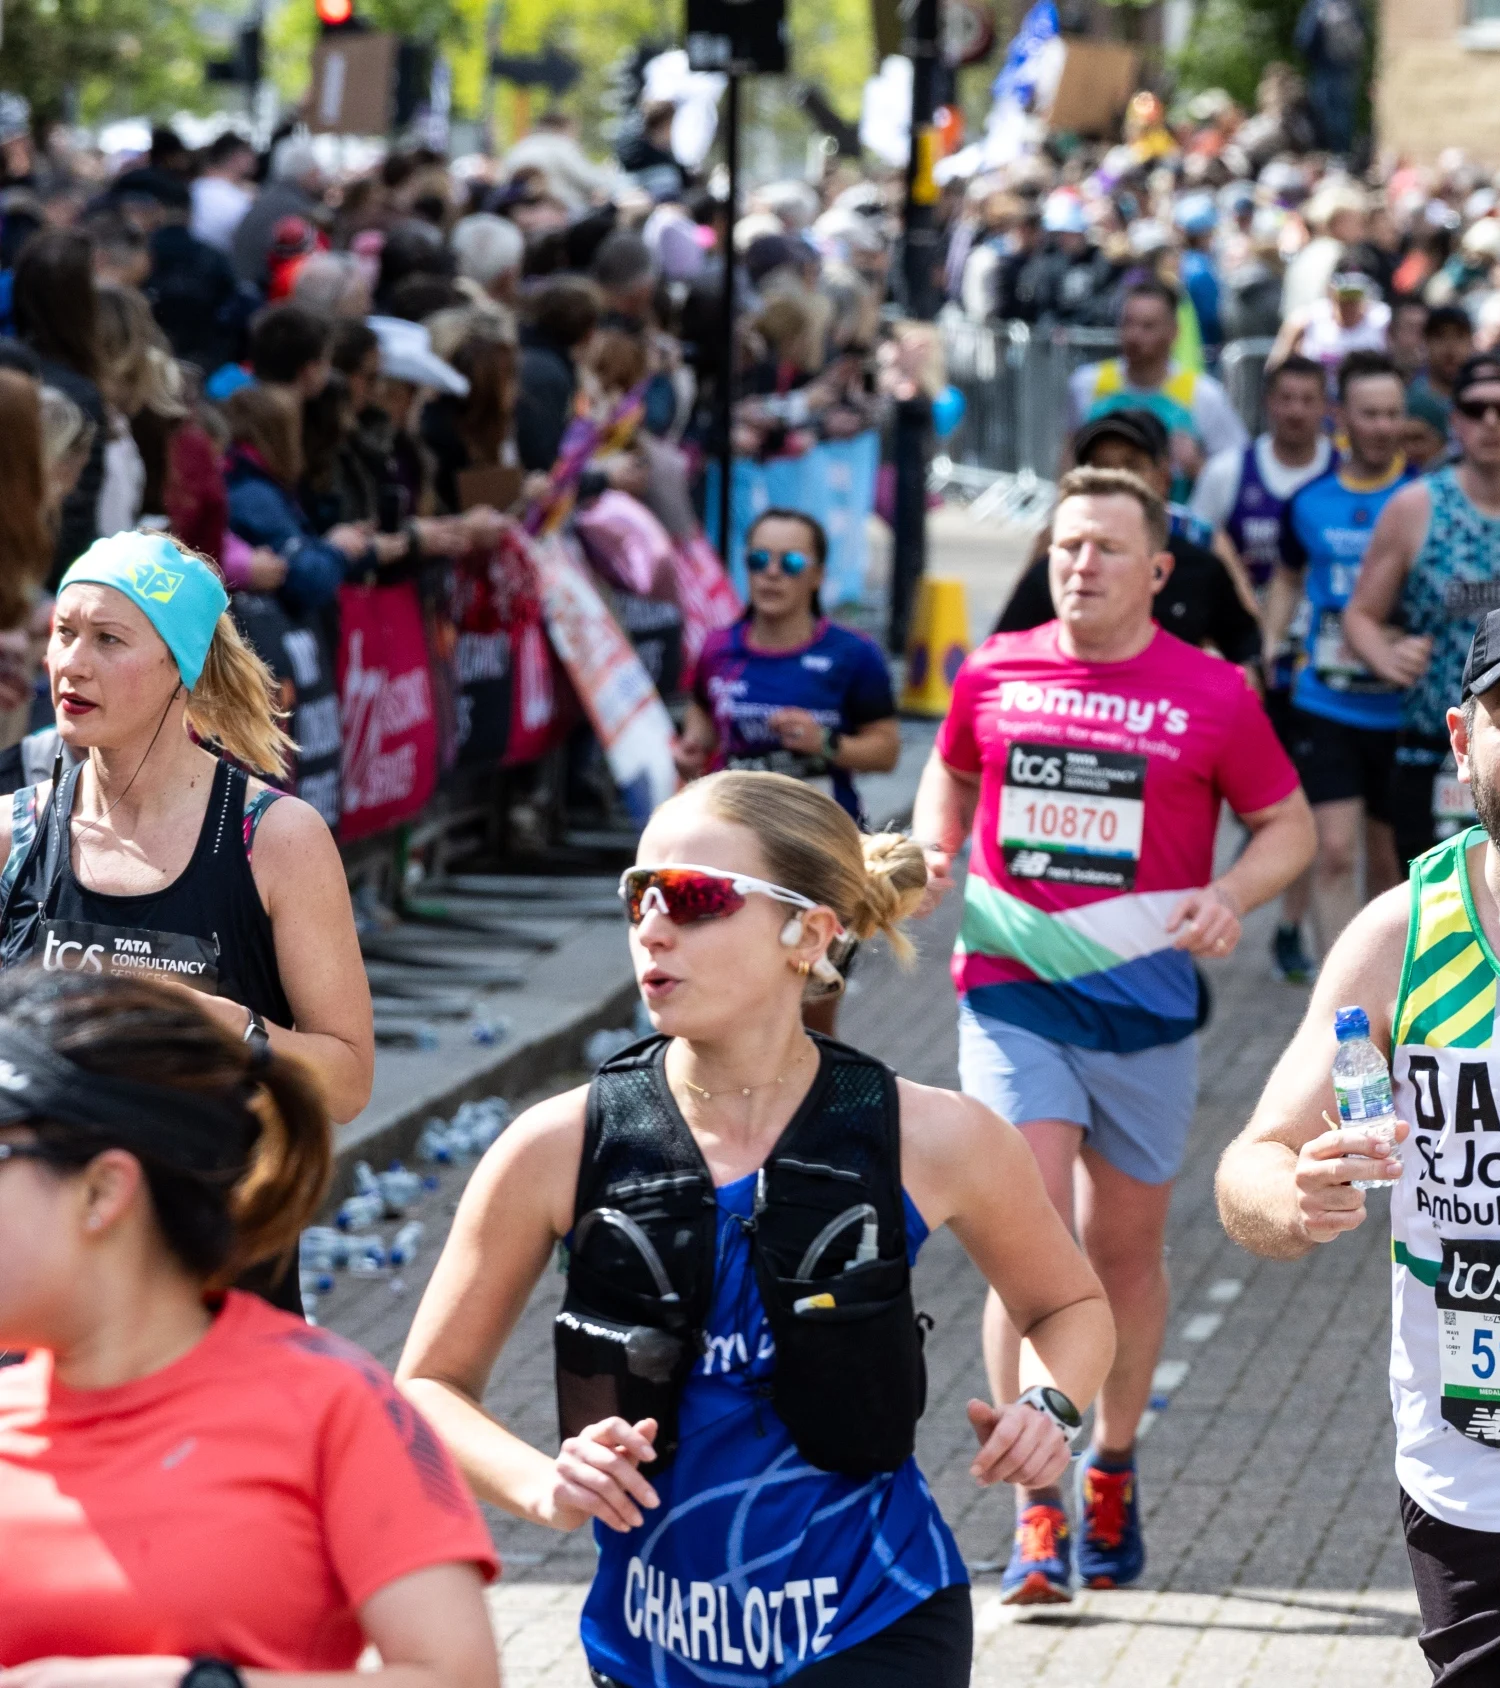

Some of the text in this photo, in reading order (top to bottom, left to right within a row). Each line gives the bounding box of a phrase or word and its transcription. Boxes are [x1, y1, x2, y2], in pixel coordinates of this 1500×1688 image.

[1000, 681, 1189, 735] Tommy's
[1011, 747, 1062, 786] tcs
[1025, 802, 1118, 843] 10870
[42, 930, 105, 974] tcs
[112, 953, 206, 974] CONSULTANCY
[114, 938, 152, 954] TATA
[1415, 1135, 1446, 1185] St
[1479, 1388, 1500, 1396] MEDAL
[624, 1555, 839, 1671] CHARLOTTE
